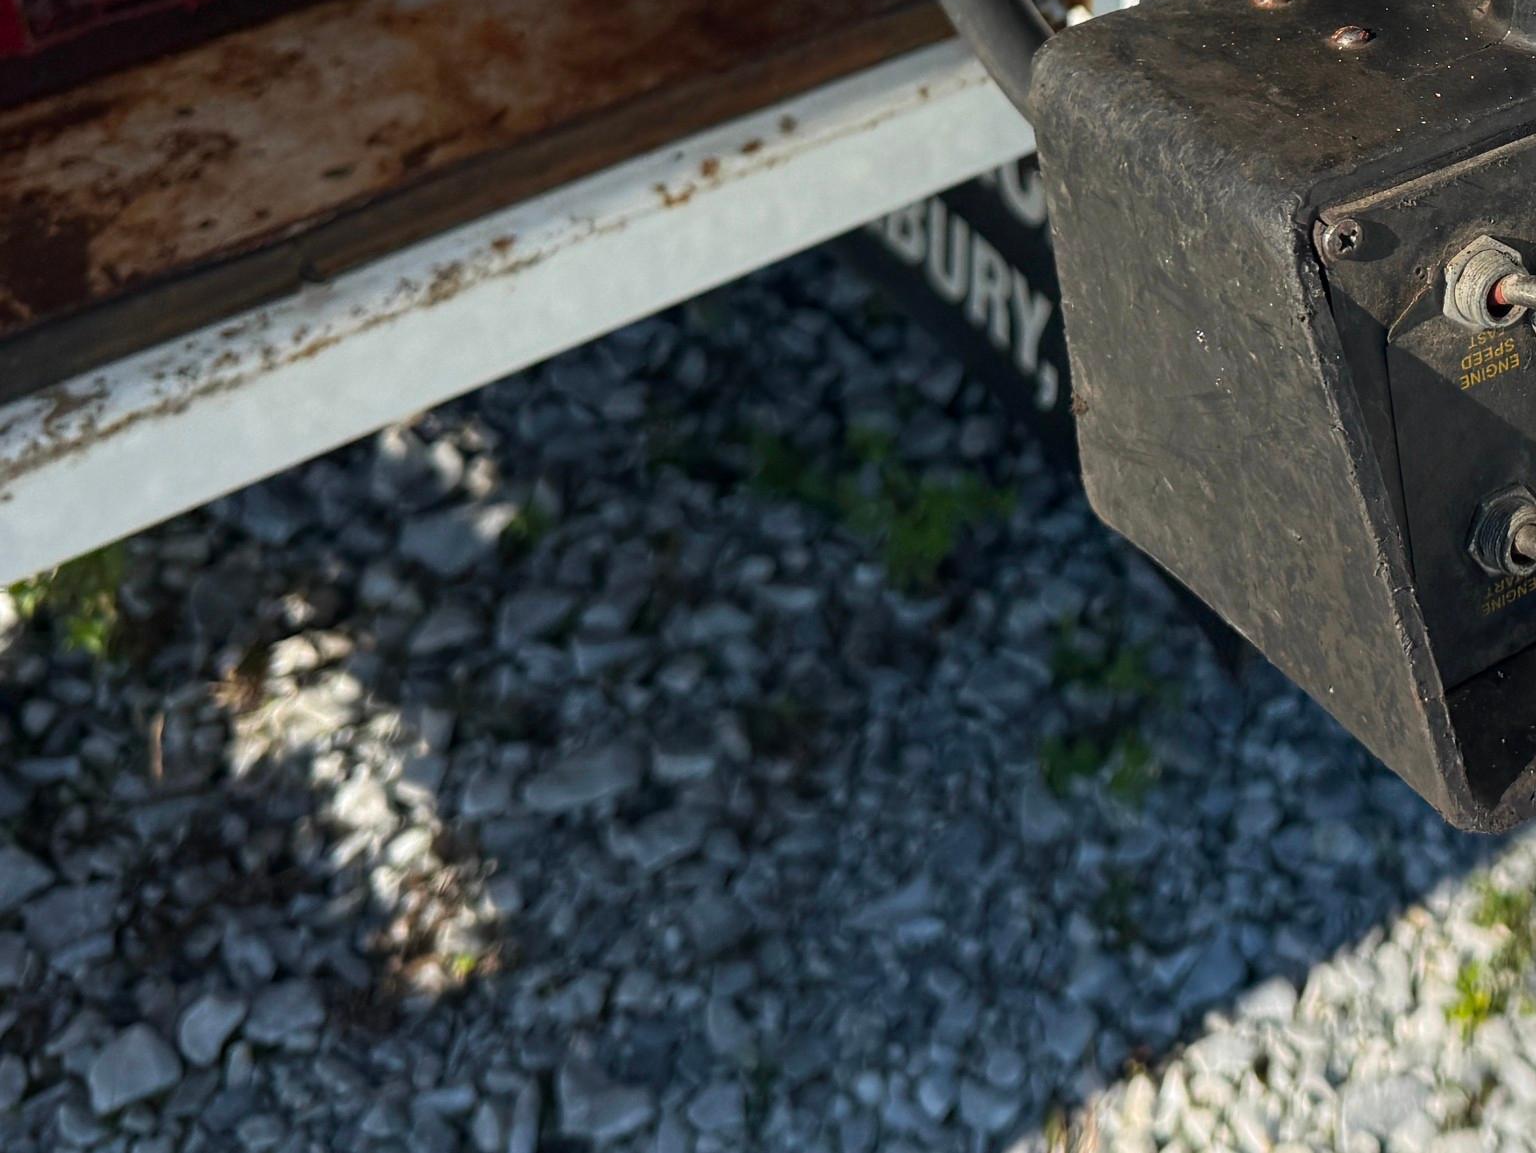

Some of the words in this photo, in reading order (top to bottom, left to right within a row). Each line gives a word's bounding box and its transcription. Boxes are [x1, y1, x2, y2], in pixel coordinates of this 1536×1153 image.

[1459, 352, 1521, 391] ENGINE
[1461, 337, 1516, 370] SPEED
[1481, 576, 1536, 617] ENGINE
